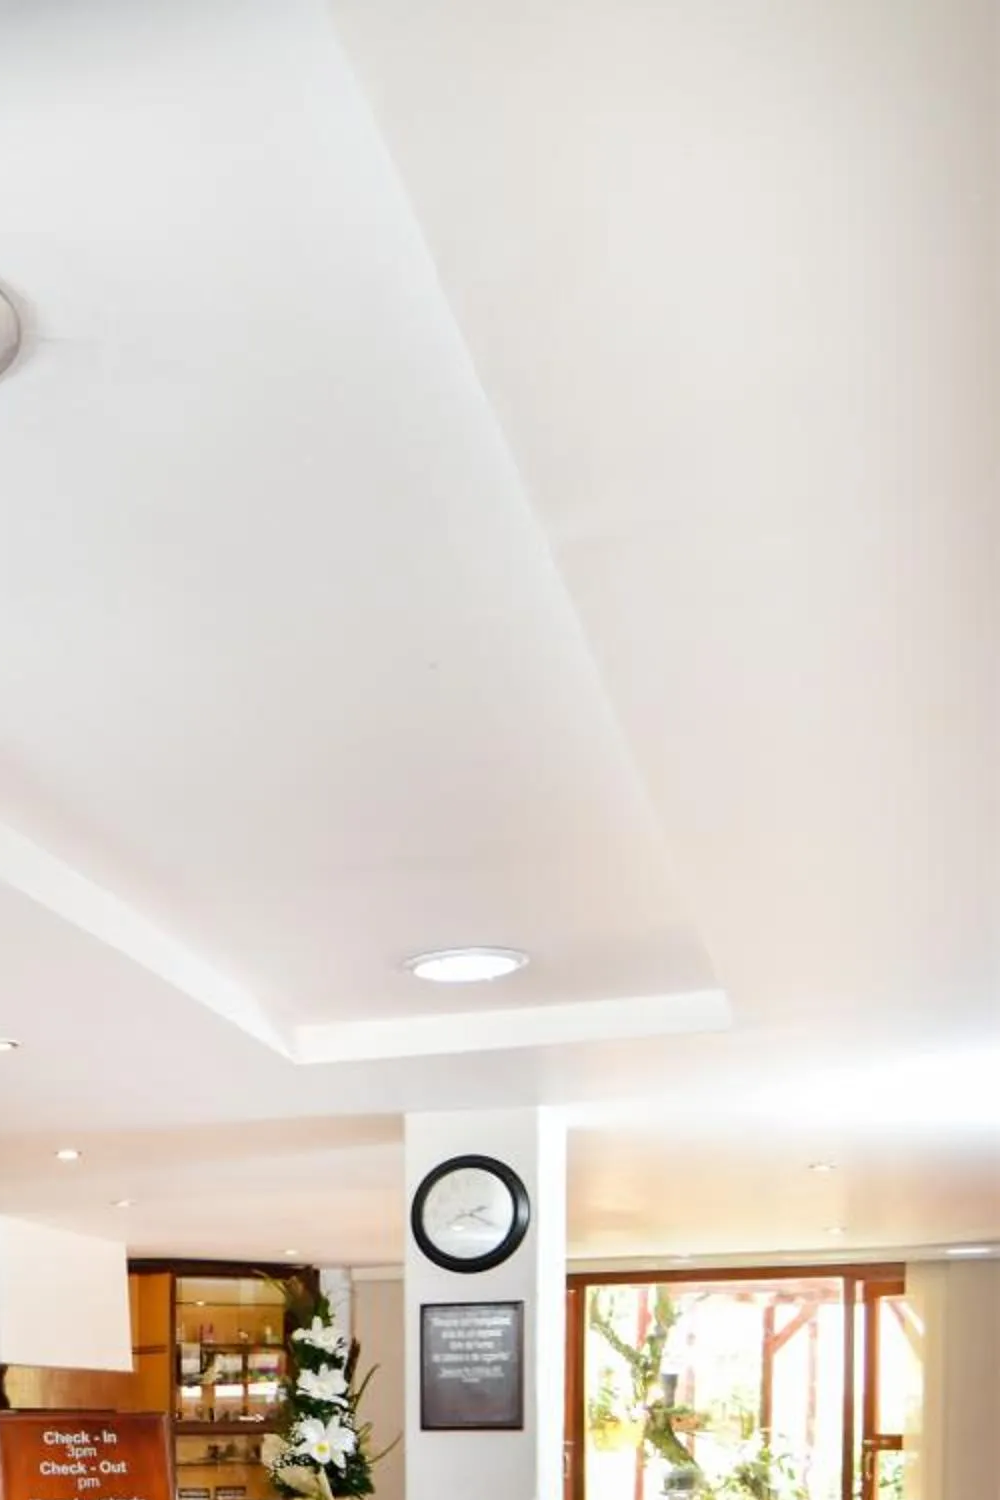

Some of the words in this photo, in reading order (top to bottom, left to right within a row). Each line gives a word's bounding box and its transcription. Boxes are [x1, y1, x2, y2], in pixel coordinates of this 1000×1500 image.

[43, 1430, 90, 1445] Check
[102, 1430, 117, 1444] In
[65, 1444, 97, 1459] 3pm
[39, 1460, 87, 1475] Check
[99, 1460, 127, 1473] Out
[77, 1477, 101, 1491] pm
